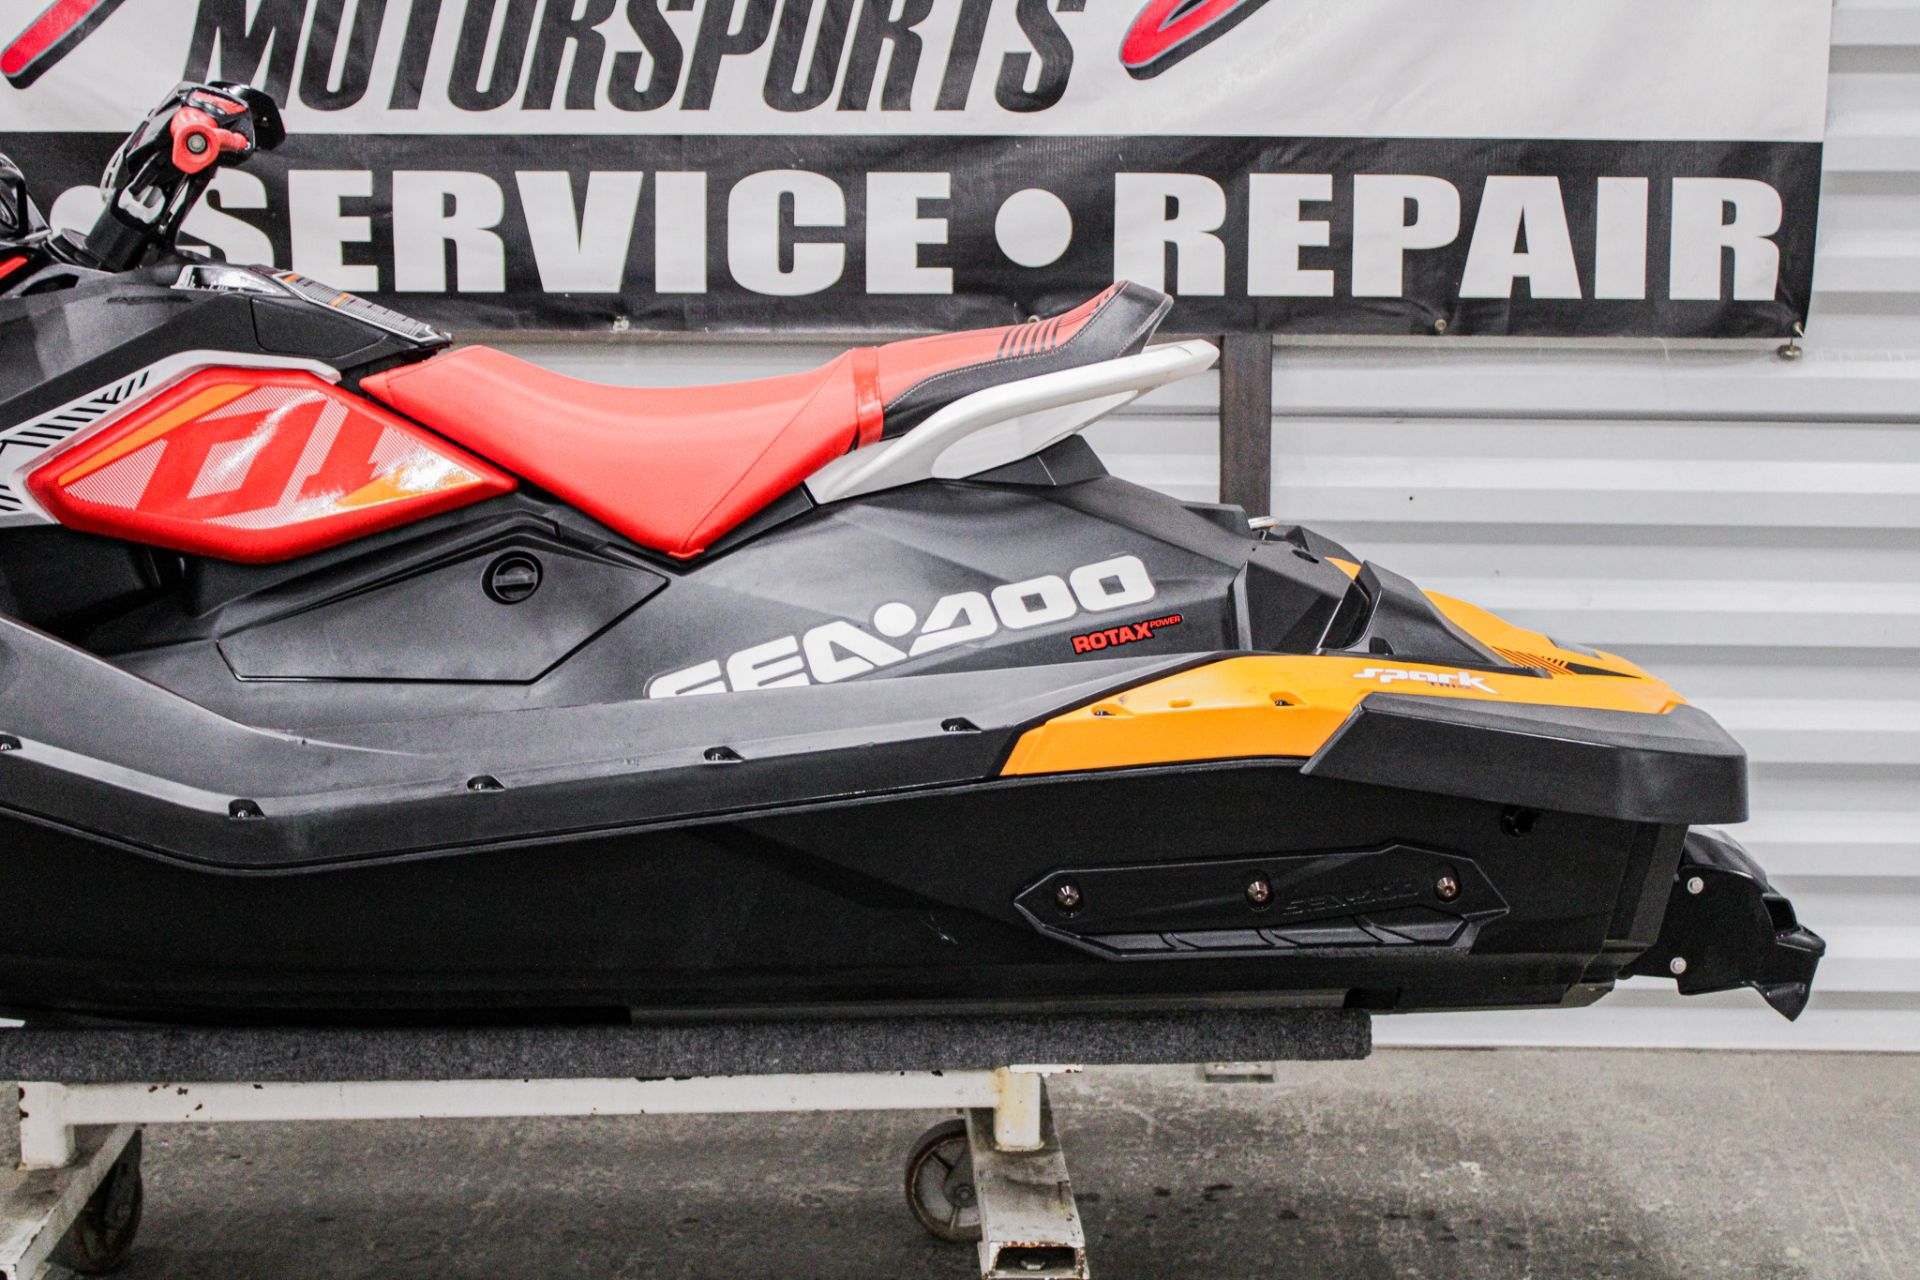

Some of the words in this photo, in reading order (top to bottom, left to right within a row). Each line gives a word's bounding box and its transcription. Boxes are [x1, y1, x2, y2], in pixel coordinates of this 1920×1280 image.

[176, 168, 954, 297] SERVICE
[1114, 172, 1784, 301] REPAIR
[1071, 622, 1154, 654] ROTAX
[1149, 614, 1182, 629] POWER
